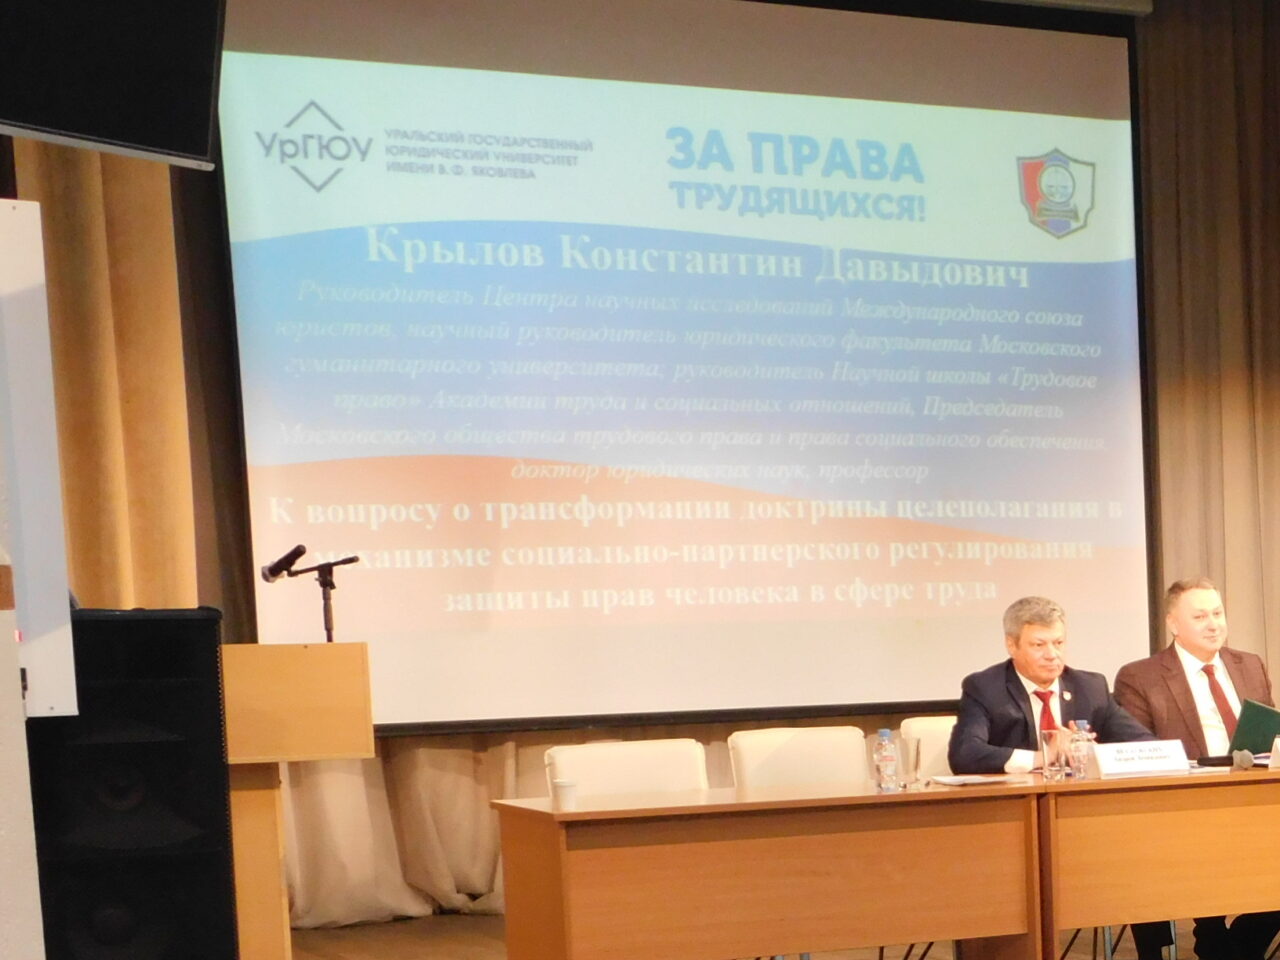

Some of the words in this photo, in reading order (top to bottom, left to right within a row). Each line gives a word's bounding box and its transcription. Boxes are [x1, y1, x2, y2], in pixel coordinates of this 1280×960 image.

[255, 131, 373, 164] УрГЮУ
[384, 127, 465, 144] УРАЛЬСКИЙ
[468, 133, 594, 152] ГОСУДАРСТВЕННЫЙ
[385, 145, 490, 162] ЮРИДИЧЕСКИЙ
[493, 152, 579, 167] УНИВЕРСИТЕТ
[666, 126, 734, 174] ЗА
[747, 131, 925, 183] ПРАВА
[386, 161, 435, 174] ИМЕНИ
[471, 165, 537, 179] ЯКОВЛЕВА
[668, 180, 927, 222] ТРУДЯЩИХСЯ!
[366, 225, 545, 274] Крылов
[560, 234, 803, 279] Константин
[815, 245, 1030, 289] Давыдович
[298, 279, 474, 306] Руководитель
[483, 284, 578, 312] Центра
[585, 294, 680, 314] научных
[686, 296, 834, 317] исследований
[841, 297, 1020, 326] Международного
[1025, 309, 1085, 328] союза
[407, 321, 511, 345] научный
[516, 323, 677, 347] руководитель
[685, 326, 836, 350] юридического
[841, 328, 972, 355] факультета
[979, 333, 1102, 358] Московского
[284, 357, 482, 380] гуманитарного
[672, 362, 825, 384] руководитель
[832, 361, 921, 387] Научной
[926, 368, 992, 386] школы
[998, 366, 1098, 391] «Трудовое
[427, 389, 547, 410] Академии
[555, 391, 627, 416] труда
[635, 397, 647, 411] и
[654, 397, 783, 417] социальных
[923, 395, 1064, 421] Председатель
[278, 422, 437, 445] Московского
[443, 422, 567, 448] общества
[573, 425, 693, 450] трудового
[699, 430, 763, 451] права
[769, 431, 782, 446] и
[788, 431, 850, 451] права
[855, 432, 981, 451] социального
[511, 458, 599, 484] доктор
[607, 458, 751, 484] юридических
[818, 459, 930, 485] профессор
[270, 497, 294, 524] К
[307, 501, 446, 530] вопросу
[453, 502, 471, 522] о
[480, 495, 731, 529] трансформации
[740, 500, 887, 525] доктрины
[897, 500, 1099, 521] целеполагания
[1104, 501, 1123, 519] в
[502, 540, 880, 567] социально-партнерского
[890, 540, 1095, 566] регулирования
[443, 588, 570, 613] защиты
[582, 588, 655, 614] прав
[665, 584, 799, 607] человека
[811, 583, 825, 602] в
[835, 577, 915, 609] сфере
[925, 581, 997, 607] труда
